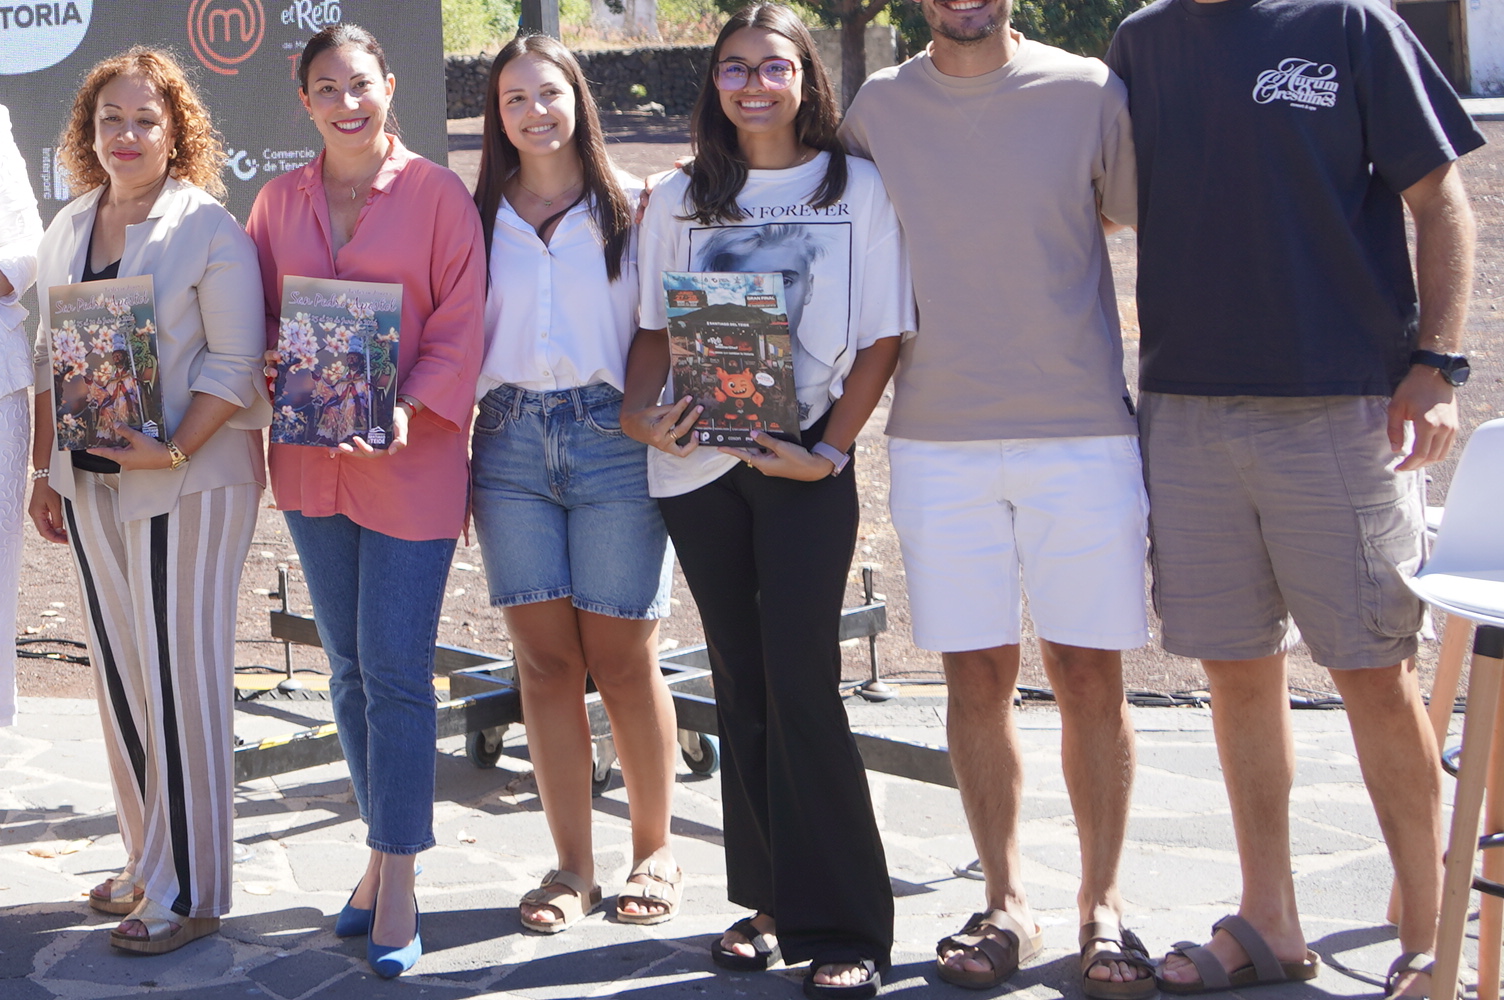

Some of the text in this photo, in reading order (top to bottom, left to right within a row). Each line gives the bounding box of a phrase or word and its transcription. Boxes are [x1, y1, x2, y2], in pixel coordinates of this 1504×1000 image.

[1278, 57, 1339, 93] Aurum
[263, 147, 315, 159] Comercio
[263, 161, 277, 172] de
[760, 203, 850, 218] FOREVER
